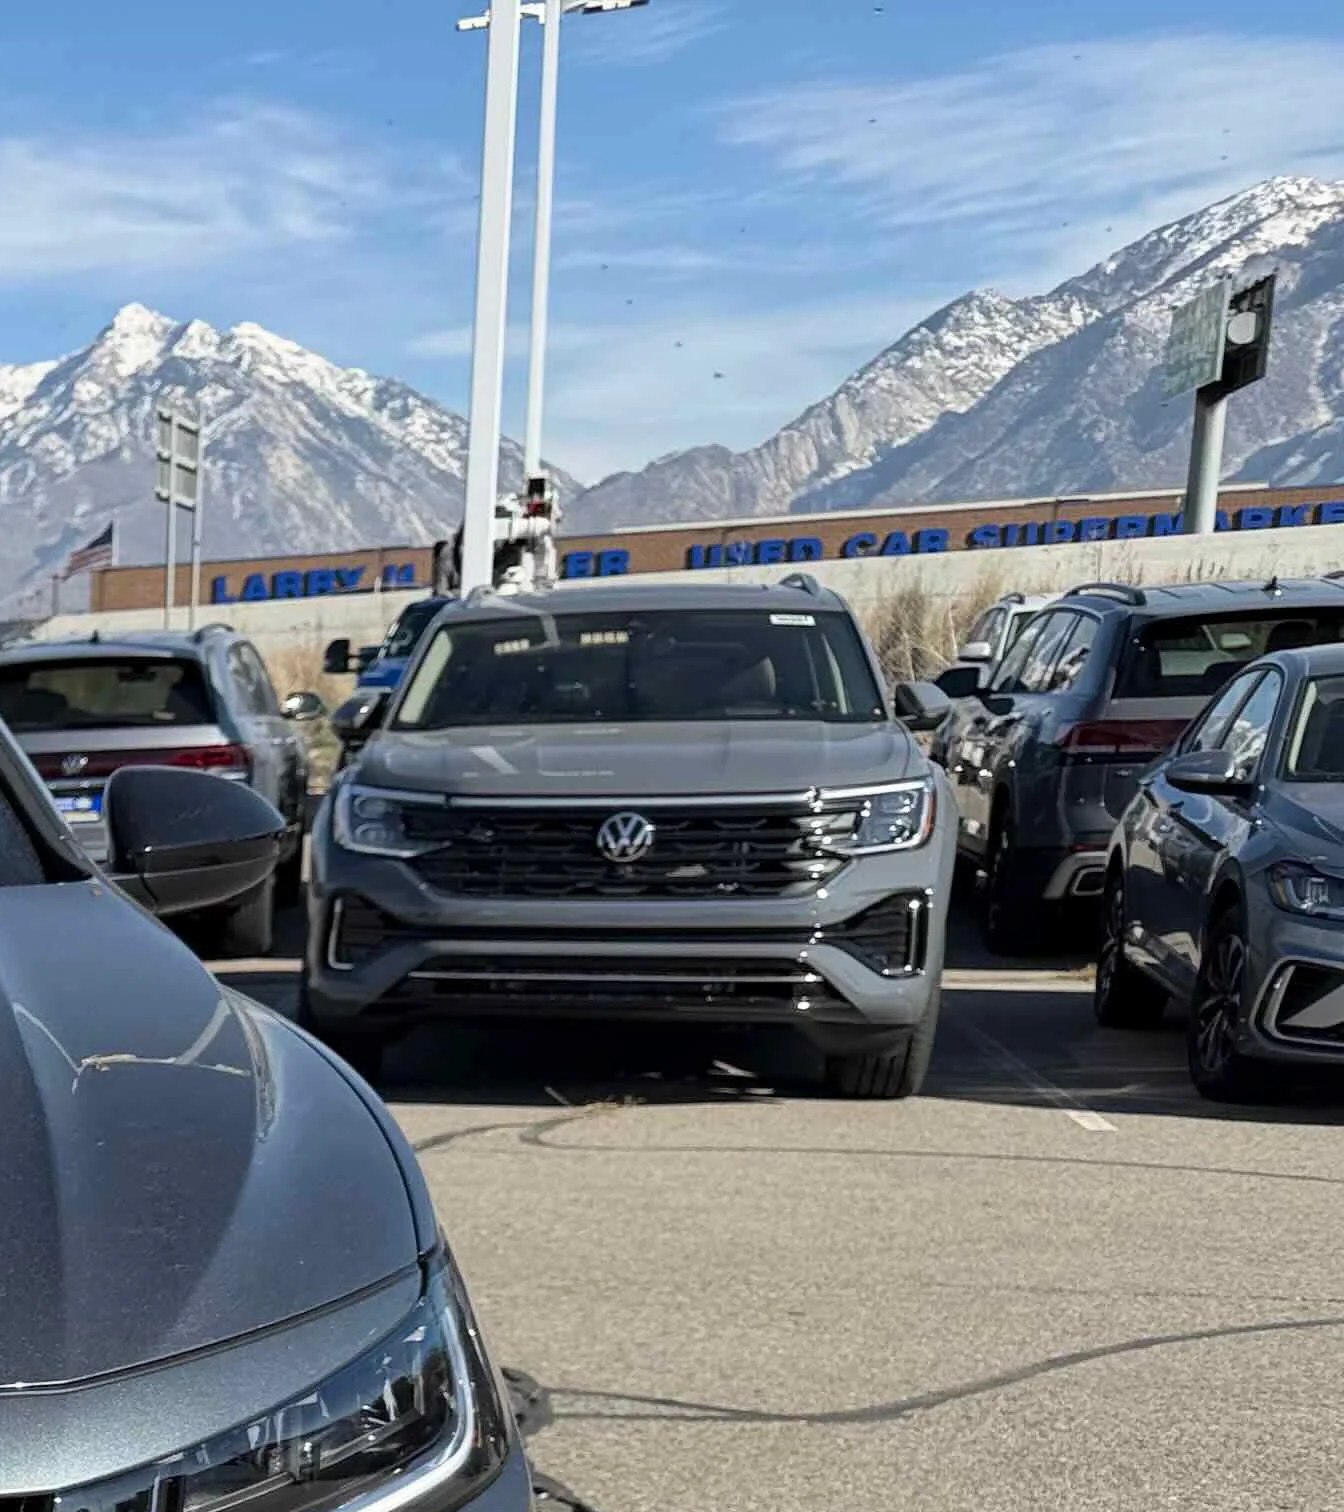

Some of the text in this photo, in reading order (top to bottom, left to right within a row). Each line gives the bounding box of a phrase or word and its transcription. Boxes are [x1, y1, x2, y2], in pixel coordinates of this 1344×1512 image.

[211, 565, 366, 604] LARRY
[687, 536, 823, 569] USED
[842, 527, 949, 557] CAR
